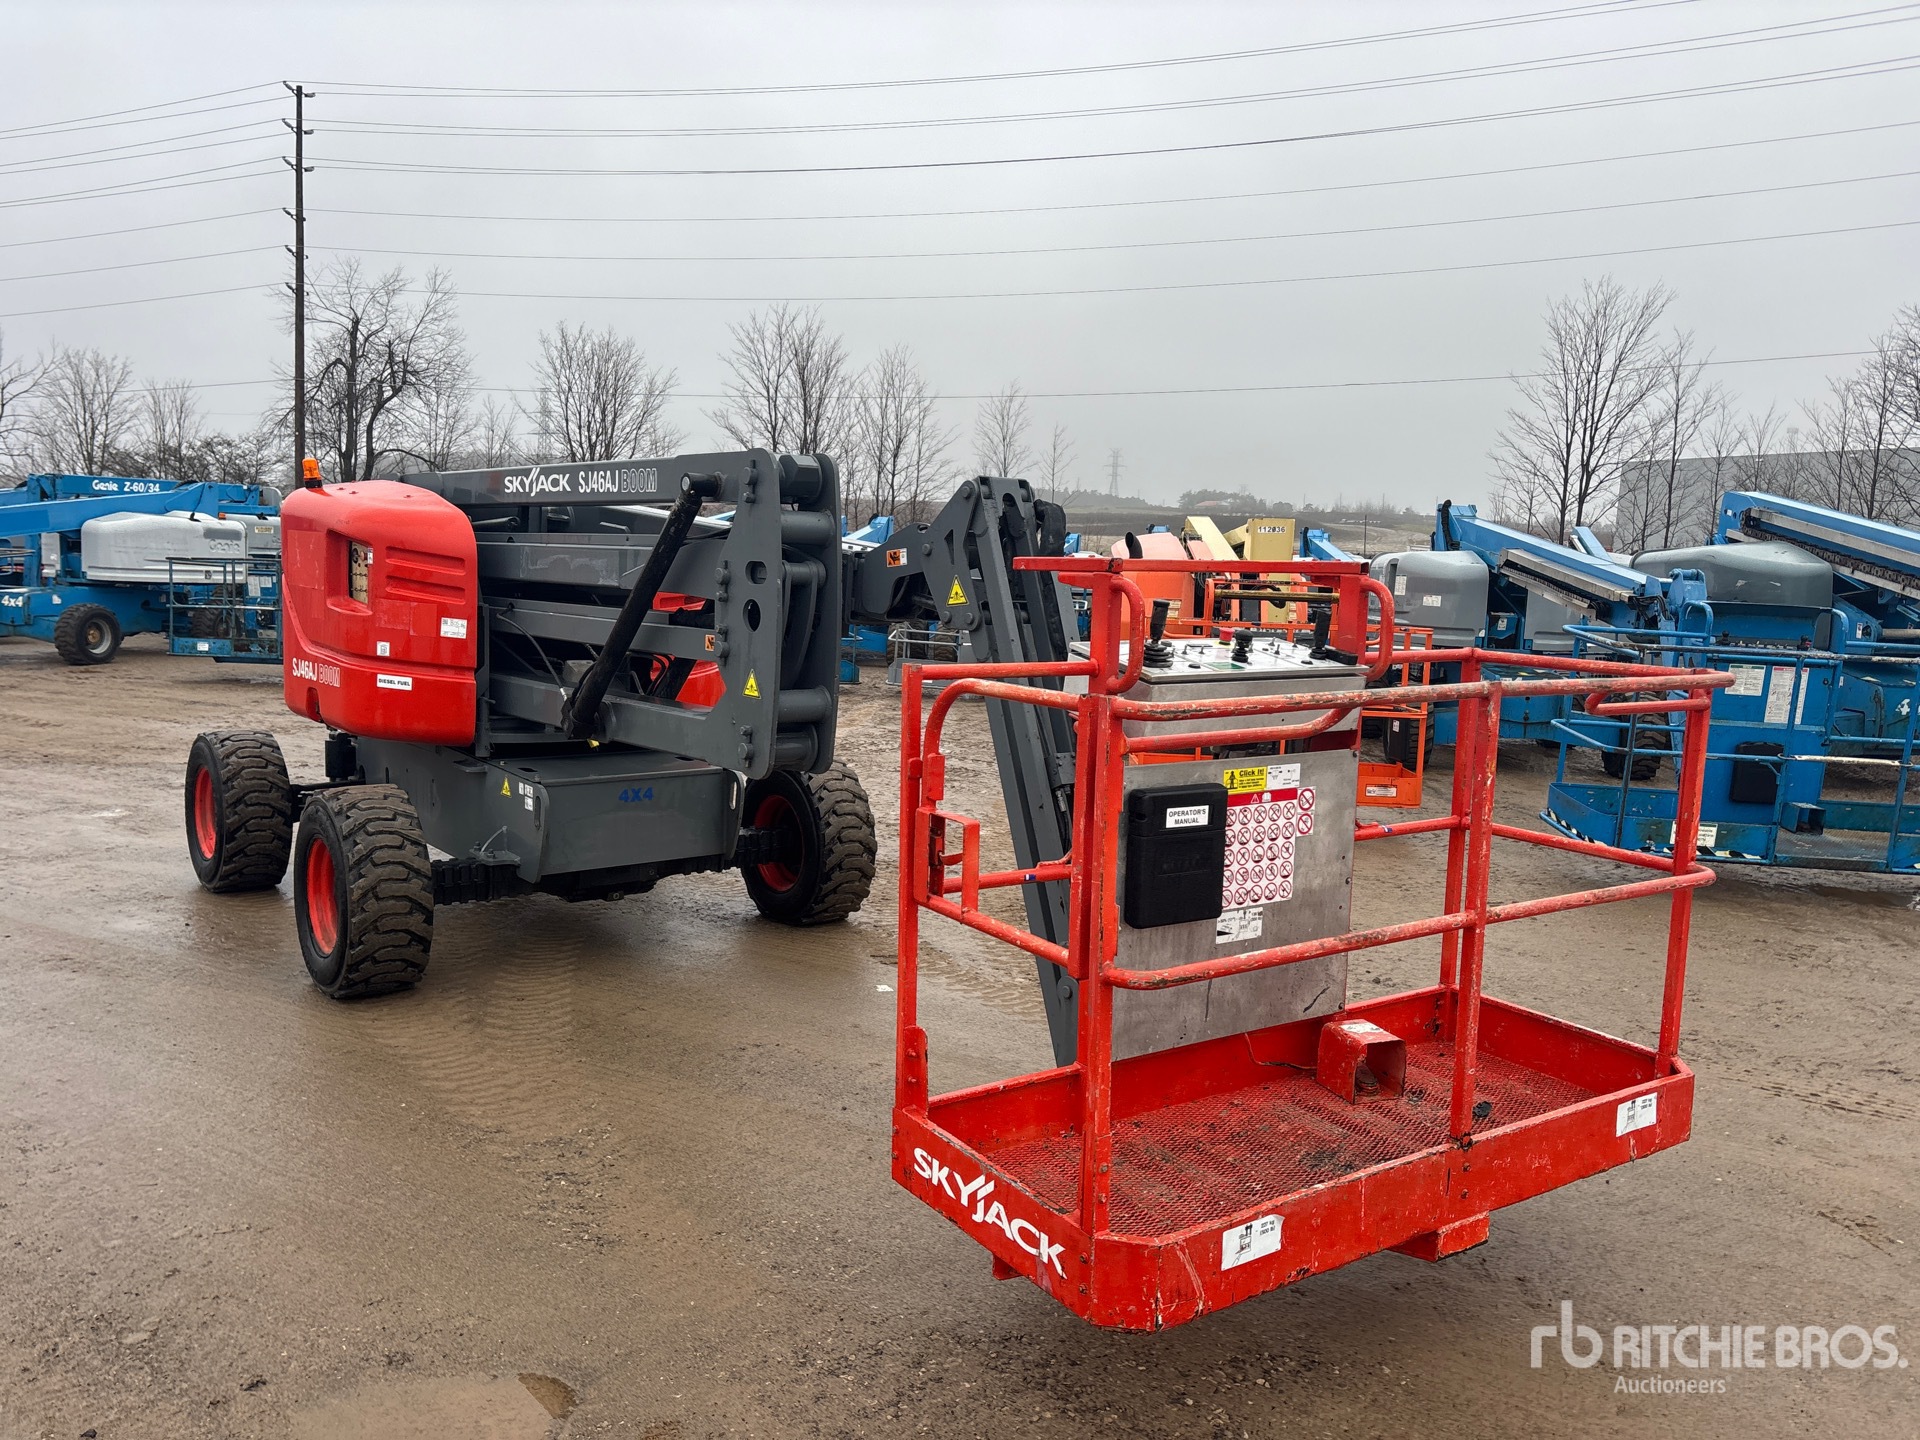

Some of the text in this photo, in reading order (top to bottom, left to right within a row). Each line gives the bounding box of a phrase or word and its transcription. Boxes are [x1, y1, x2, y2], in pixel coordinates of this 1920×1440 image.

[92, 479, 160, 492] Genie Z-60/34
[504, 467, 657, 497] SKYJACK SJ46AJ BOOM
[1, 595, 23, 607] 4x4
[292, 657, 340, 688] SJ46AJ BOOM
[1239, 768, 1256, 777] Click
[1168, 808, 1207, 818] OPERATOR'S
[1174, 817, 1200, 825] MANUAL
[913, 1147, 1068, 1279] SKYJACK
